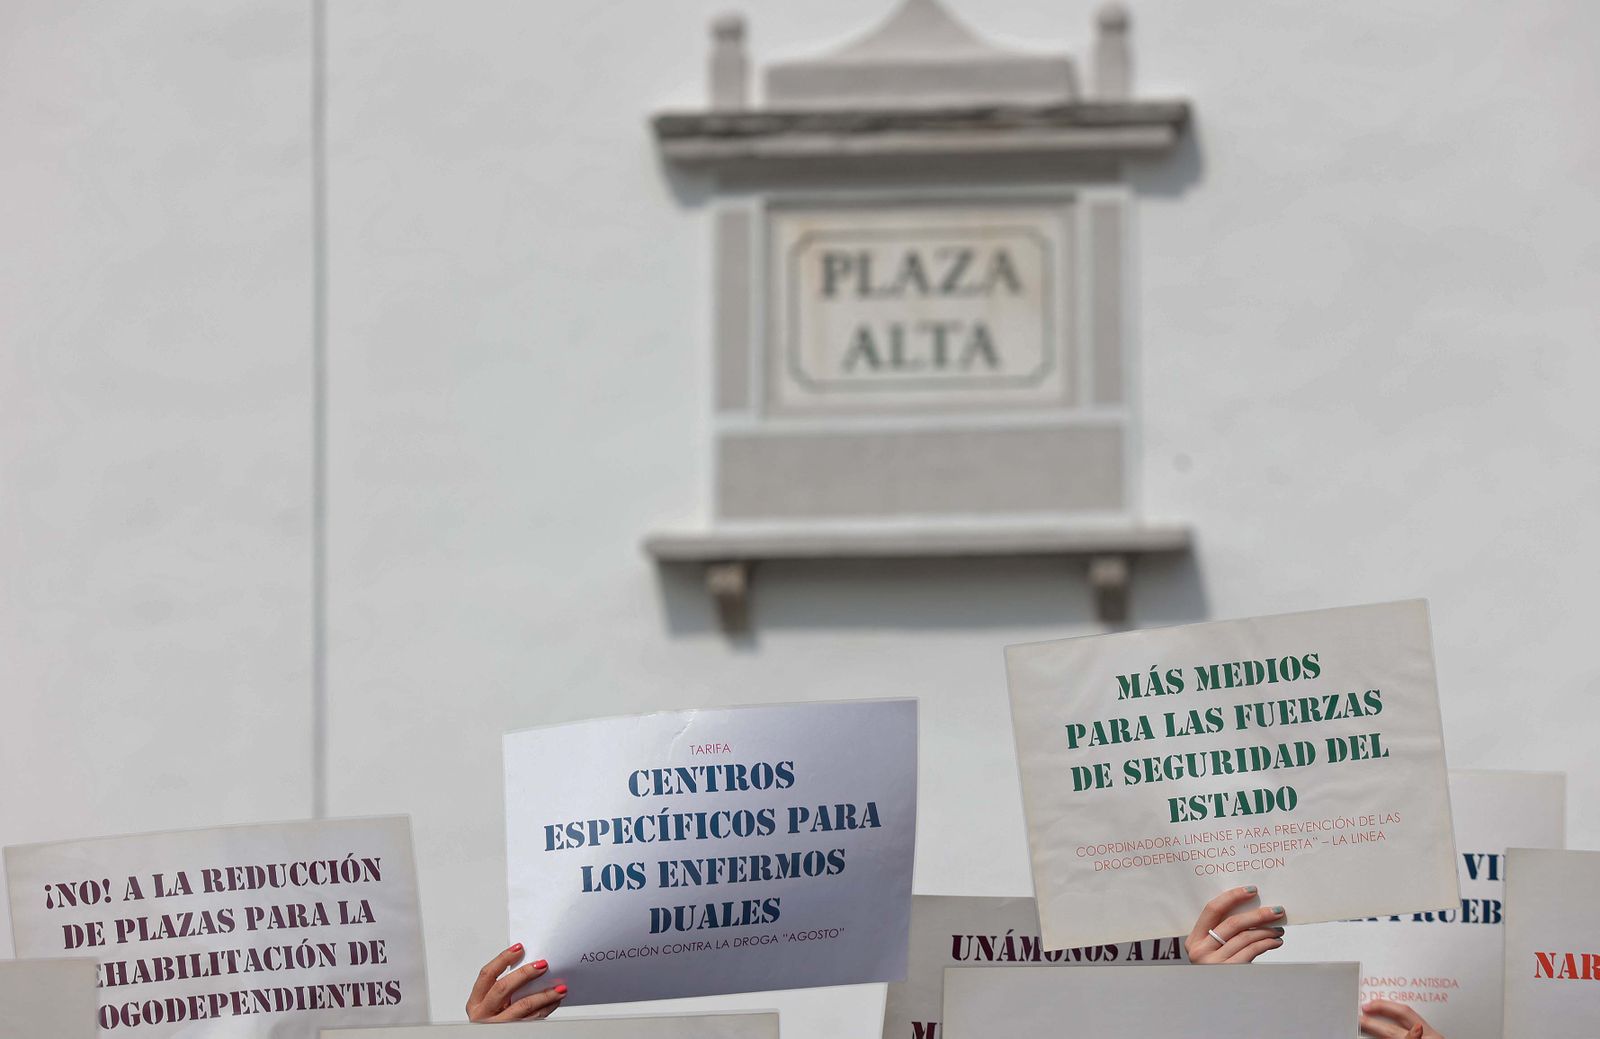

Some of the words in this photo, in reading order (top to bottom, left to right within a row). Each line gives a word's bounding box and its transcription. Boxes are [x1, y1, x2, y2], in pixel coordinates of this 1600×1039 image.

[820, 247, 1024, 298] PLAZA
[842, 321, 1003, 373] ALTA
[1116, 664, 1185, 700] MÁS
[1194, 653, 1321, 692] MEDIOS
[1065, 715, 1156, 750] PARA
[1163, 708, 1225, 738] LAS
[1235, 690, 1383, 731] FUERZAS
[689, 743, 731, 756] TARIFA
[1070, 762, 1114, 792] DE
[1123, 740, 1316, 786] SEGURIDAD
[1327, 733, 1390, 764] DEL
[628, 760, 796, 798] CENTROS
[1168, 785, 1299, 823] ESTADO
[543, 807, 777, 852] ESPECÍFICOS
[787, 801, 882, 834] PARA
[1075, 838, 1182, 859] COORDINADORA
[1183, 829, 1233, 846] LINENSE
[1236, 826, 1272, 840] PARA
[1274, 816, 1356, 837] PREVENCIÓN
[1358, 815, 1376, 828] DE
[1377, 812, 1402, 825] LAS
[580, 861, 647, 893] LOS
[657, 848, 846, 889] ENFERMOS
[1093, 846, 1237, 872] DROGODEPENDENCIAS
[1332, 836, 1349, 846] LA
[1350, 830, 1387, 844] LINEA
[1194, 857, 1286, 877] CONCEPCION
[1463, 852, 1506, 882] VI
[44, 878, 112, 910] ¡NO!
[123, 874, 145, 902] A
[152, 870, 194, 899] LA
[201, 852, 382, 894] REDUCCIÓN
[62, 921, 106, 950] DE
[114, 907, 236, 945] PLAZAS
[244, 901, 331, 931] PARA
[337, 899, 377, 926] LA
[648, 897, 781, 934] DUALES
[348, 939, 389, 966] DE
[580, 944, 660, 964] ASOCIACIÓN
[662, 941, 713, 955] CONTRA
[715, 939, 731, 949] LA
[733, 933, 779, 948] DROGA
[1126, 940, 1144, 961] A
[1360, 976, 1408, 988] ADANO
[1410, 977, 1460, 990] ANTISIDA
[1388, 991, 1449, 1003] GIBRALTAR
